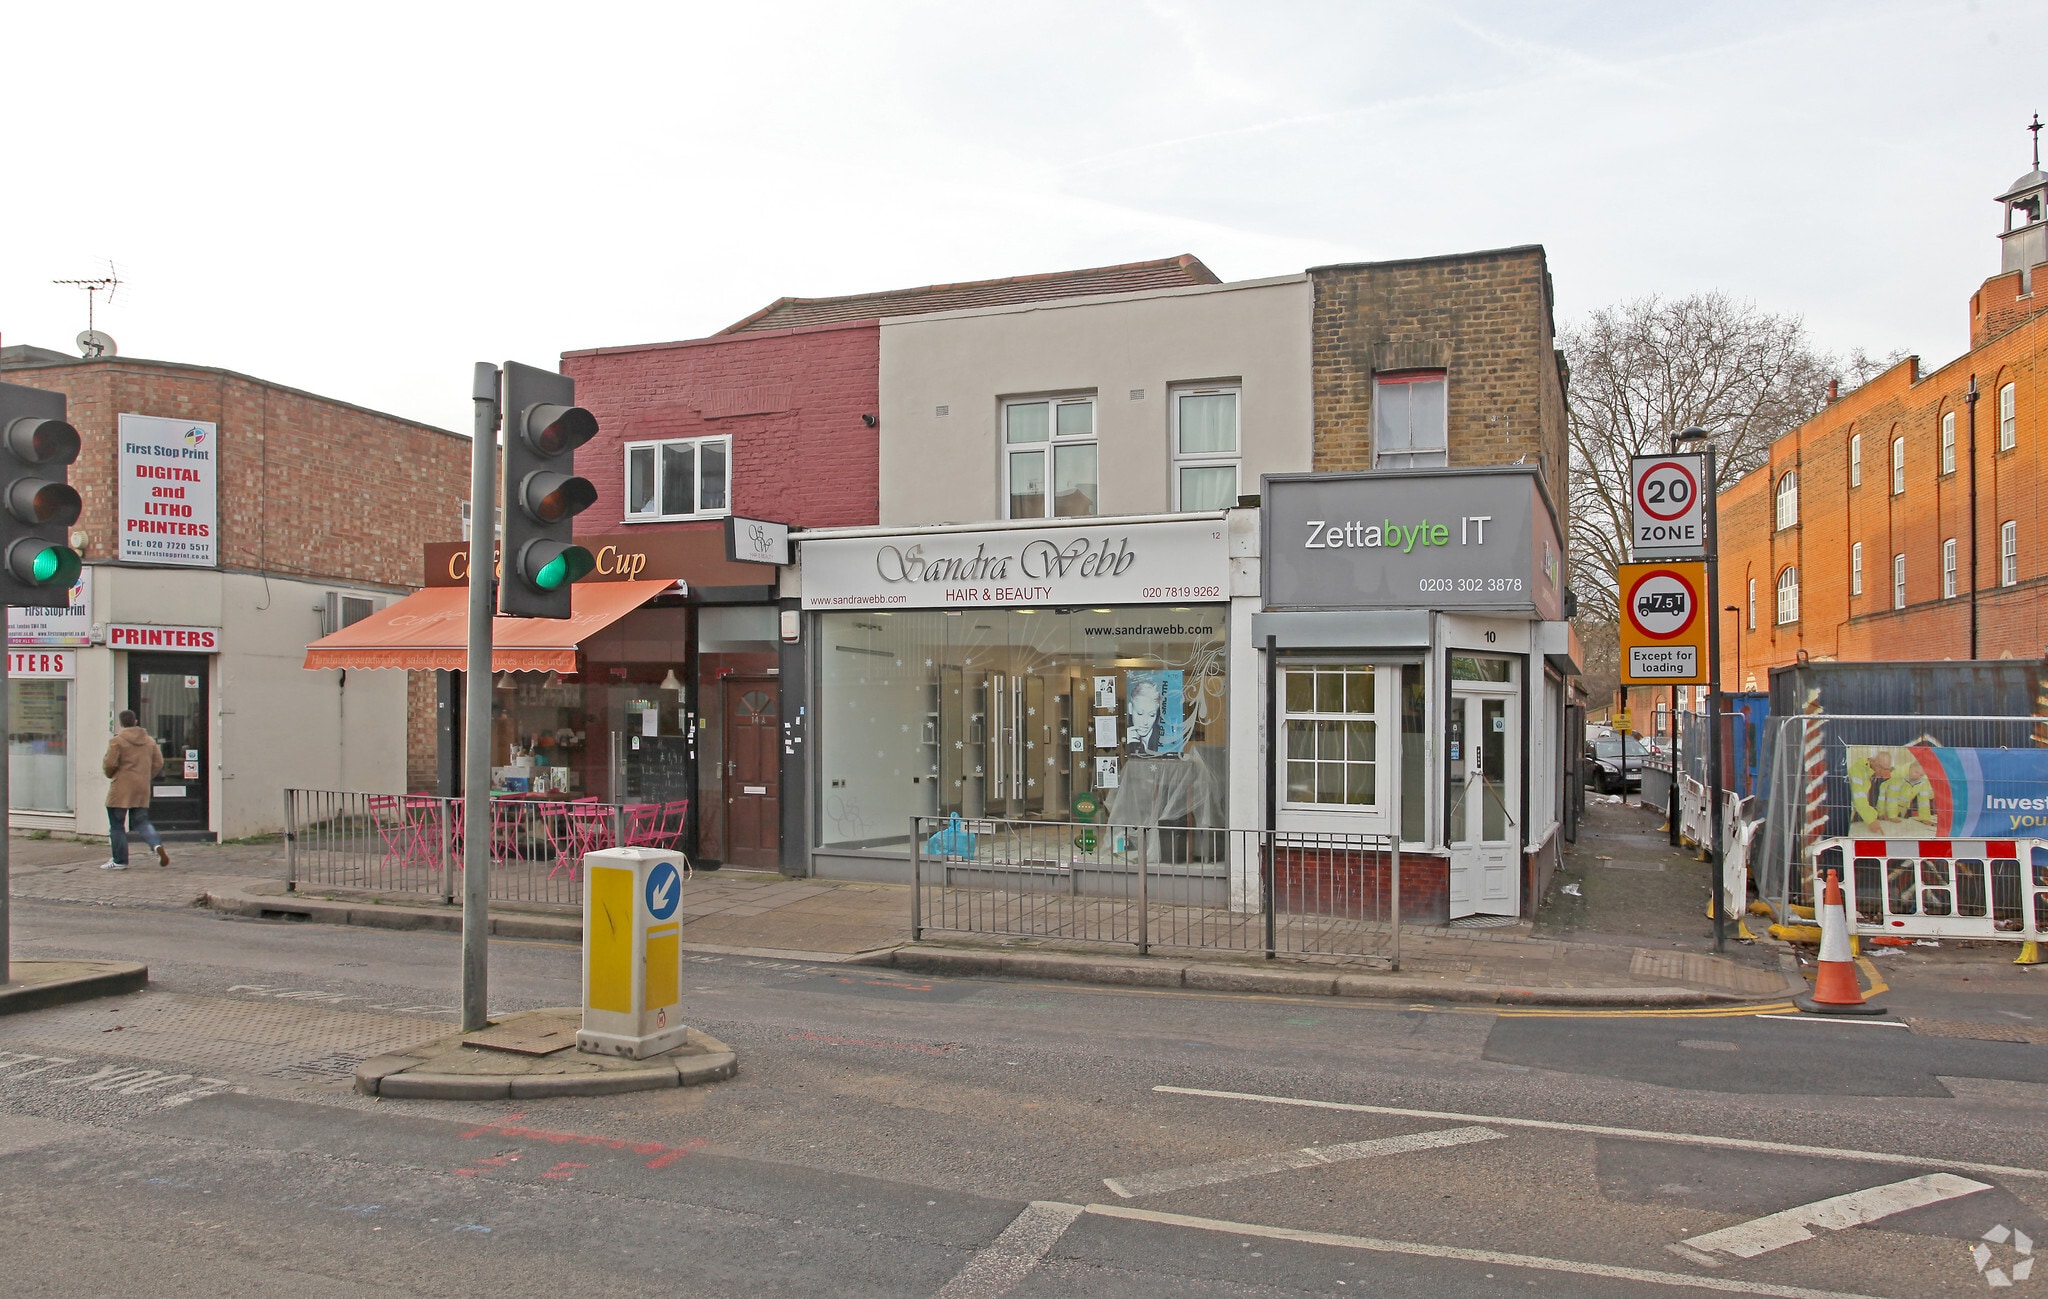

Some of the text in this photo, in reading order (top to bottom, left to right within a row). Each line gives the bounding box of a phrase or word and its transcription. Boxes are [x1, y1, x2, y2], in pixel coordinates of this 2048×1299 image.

[126, 442, 209, 460] First Stop Print
[136, 464, 201, 482] DIGITAL
[152, 486, 185, 499] and
[1647, 479, 1689, 504] 20
[144, 502, 193, 518] LITHO
[127, 519, 210, 537] PRINTERS
[1304, 515, 1492, 554] Zettabyte IT
[1641, 525, 1695, 541] ZONE
[1212, 531, 1221, 540] 12
[126, 539, 209, 552] Tel: 020 7720 5517
[126, 550, 209, 560] www.firststopprint.co.uk
[876, 536, 1136, 583] Sandra Webb
[596, 545, 646, 582] Cup
[1142, 586, 1220, 598] 020 7819 9262
[1419, 578, 1522, 592] 0203 302 3878
[810, 594, 907, 605] www.sandrawebb.com
[945, 586, 1052, 602] HAIR & BEAUTY
[1653, 594, 1683, 609] 7.5 T
[65, 604, 86, 616] Print
[1084, 624, 1213, 636] www.sandrawebb.com
[1483, 630, 1496, 643] 10
[111, 628, 215, 648] PRINTERS
[1633, 650, 1692, 662] Except for
[1642, 663, 1684, 674] loading
